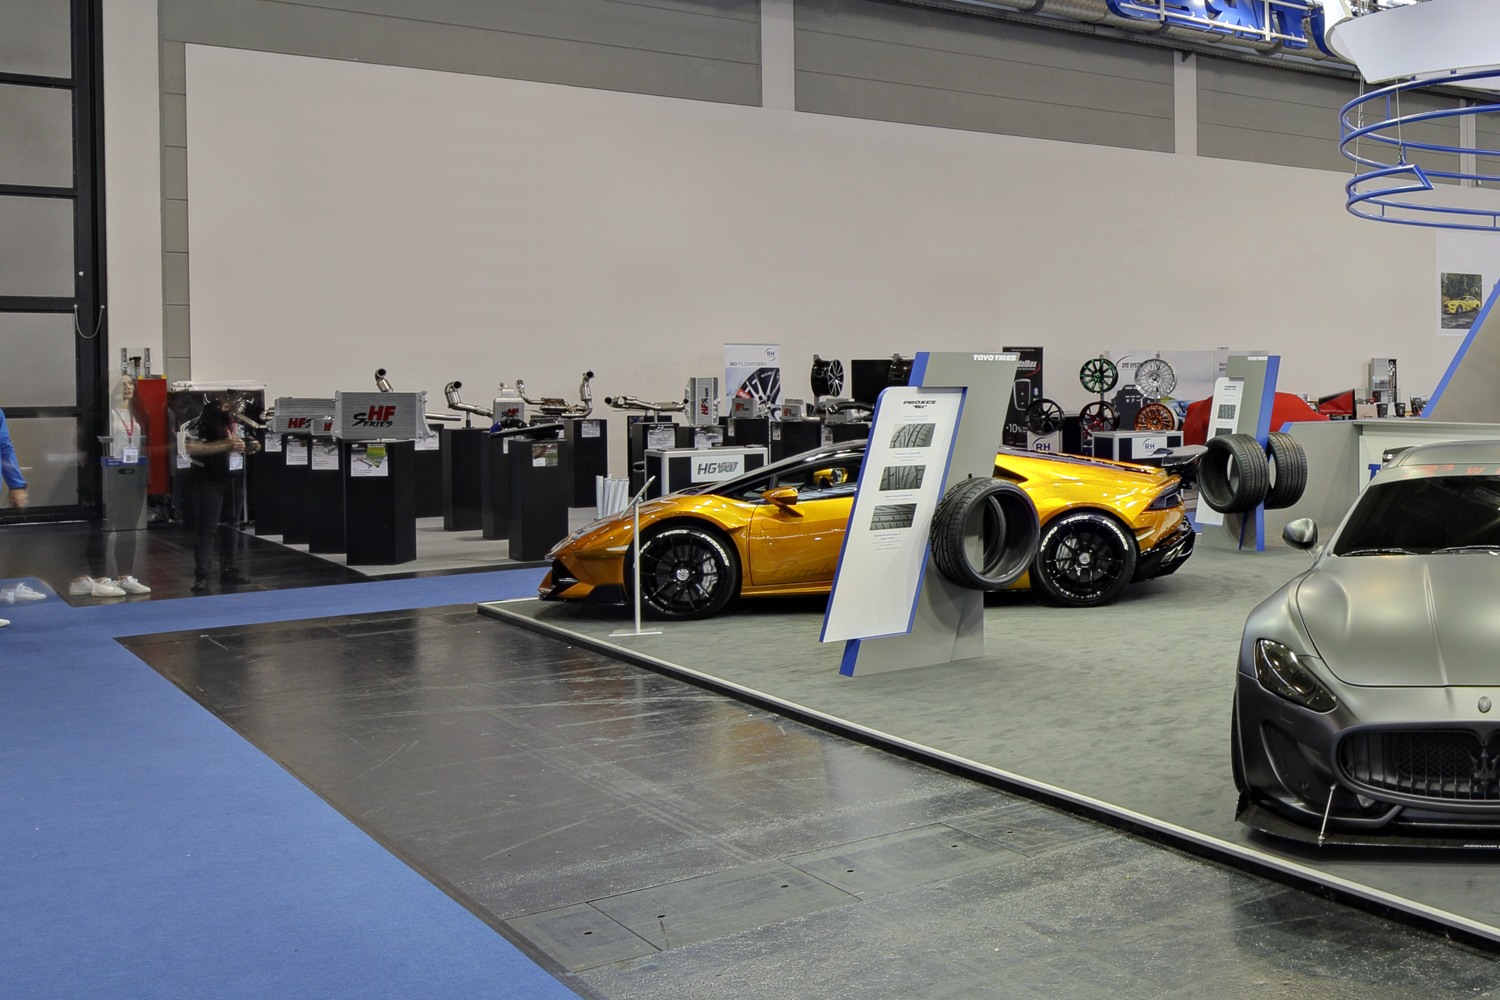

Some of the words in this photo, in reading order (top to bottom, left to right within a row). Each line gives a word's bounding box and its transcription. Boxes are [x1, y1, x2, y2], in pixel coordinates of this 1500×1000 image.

[368, 406, 396, 421] HF
[288, 418, 306, 428] HF
[697, 462, 718, 474] HG
